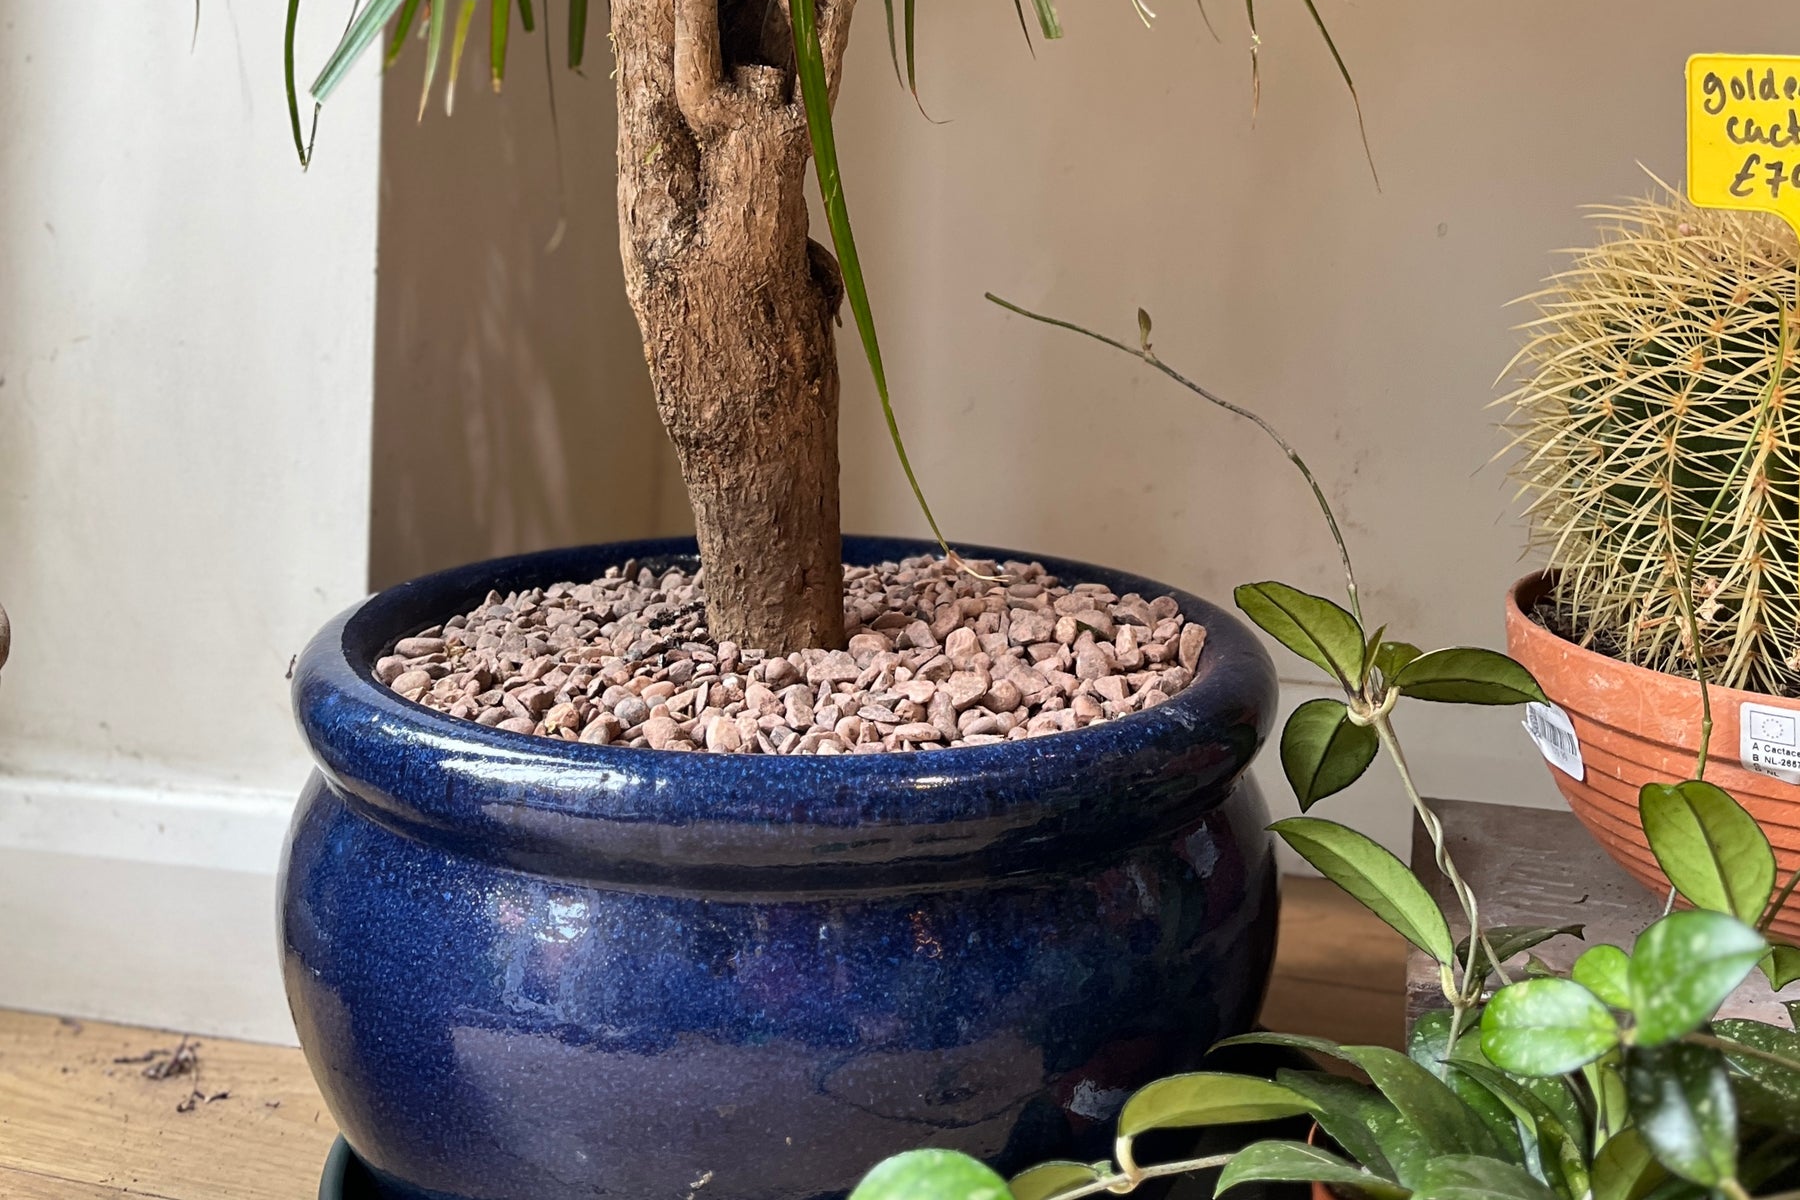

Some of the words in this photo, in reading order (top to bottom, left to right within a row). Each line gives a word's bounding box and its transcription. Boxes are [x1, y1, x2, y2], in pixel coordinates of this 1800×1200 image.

[1703, 67, 1800, 115] golde
[1752, 742, 1760, 751] A
[1752, 753, 1760, 762] B
